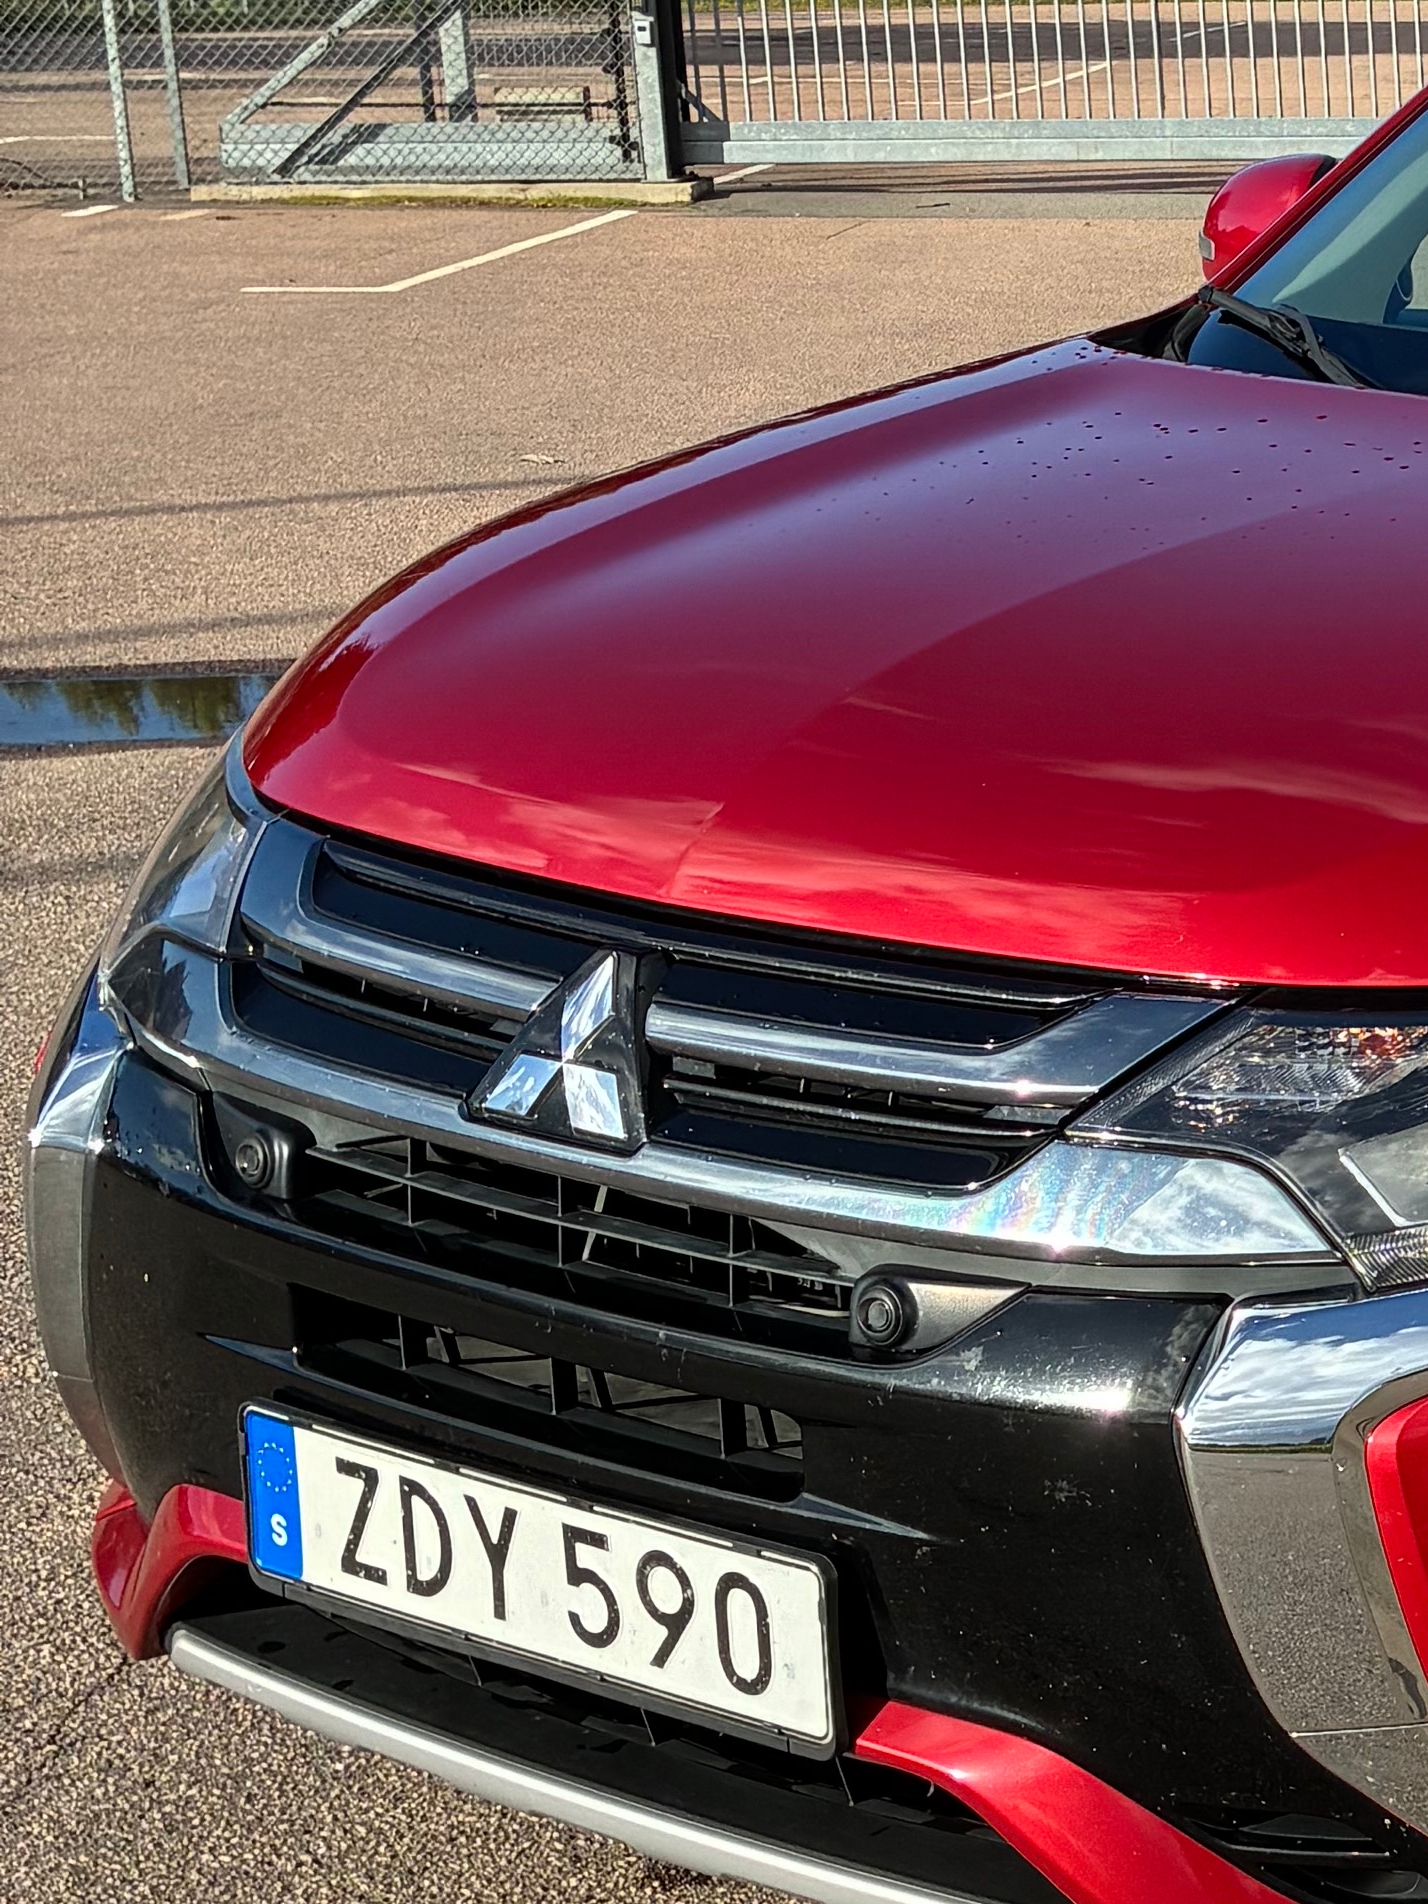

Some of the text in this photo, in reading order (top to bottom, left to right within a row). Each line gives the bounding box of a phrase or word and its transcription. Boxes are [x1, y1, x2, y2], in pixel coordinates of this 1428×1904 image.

[271, 1512, 288, 1547] S
[334, 1456, 772, 1696] ZDY 590
